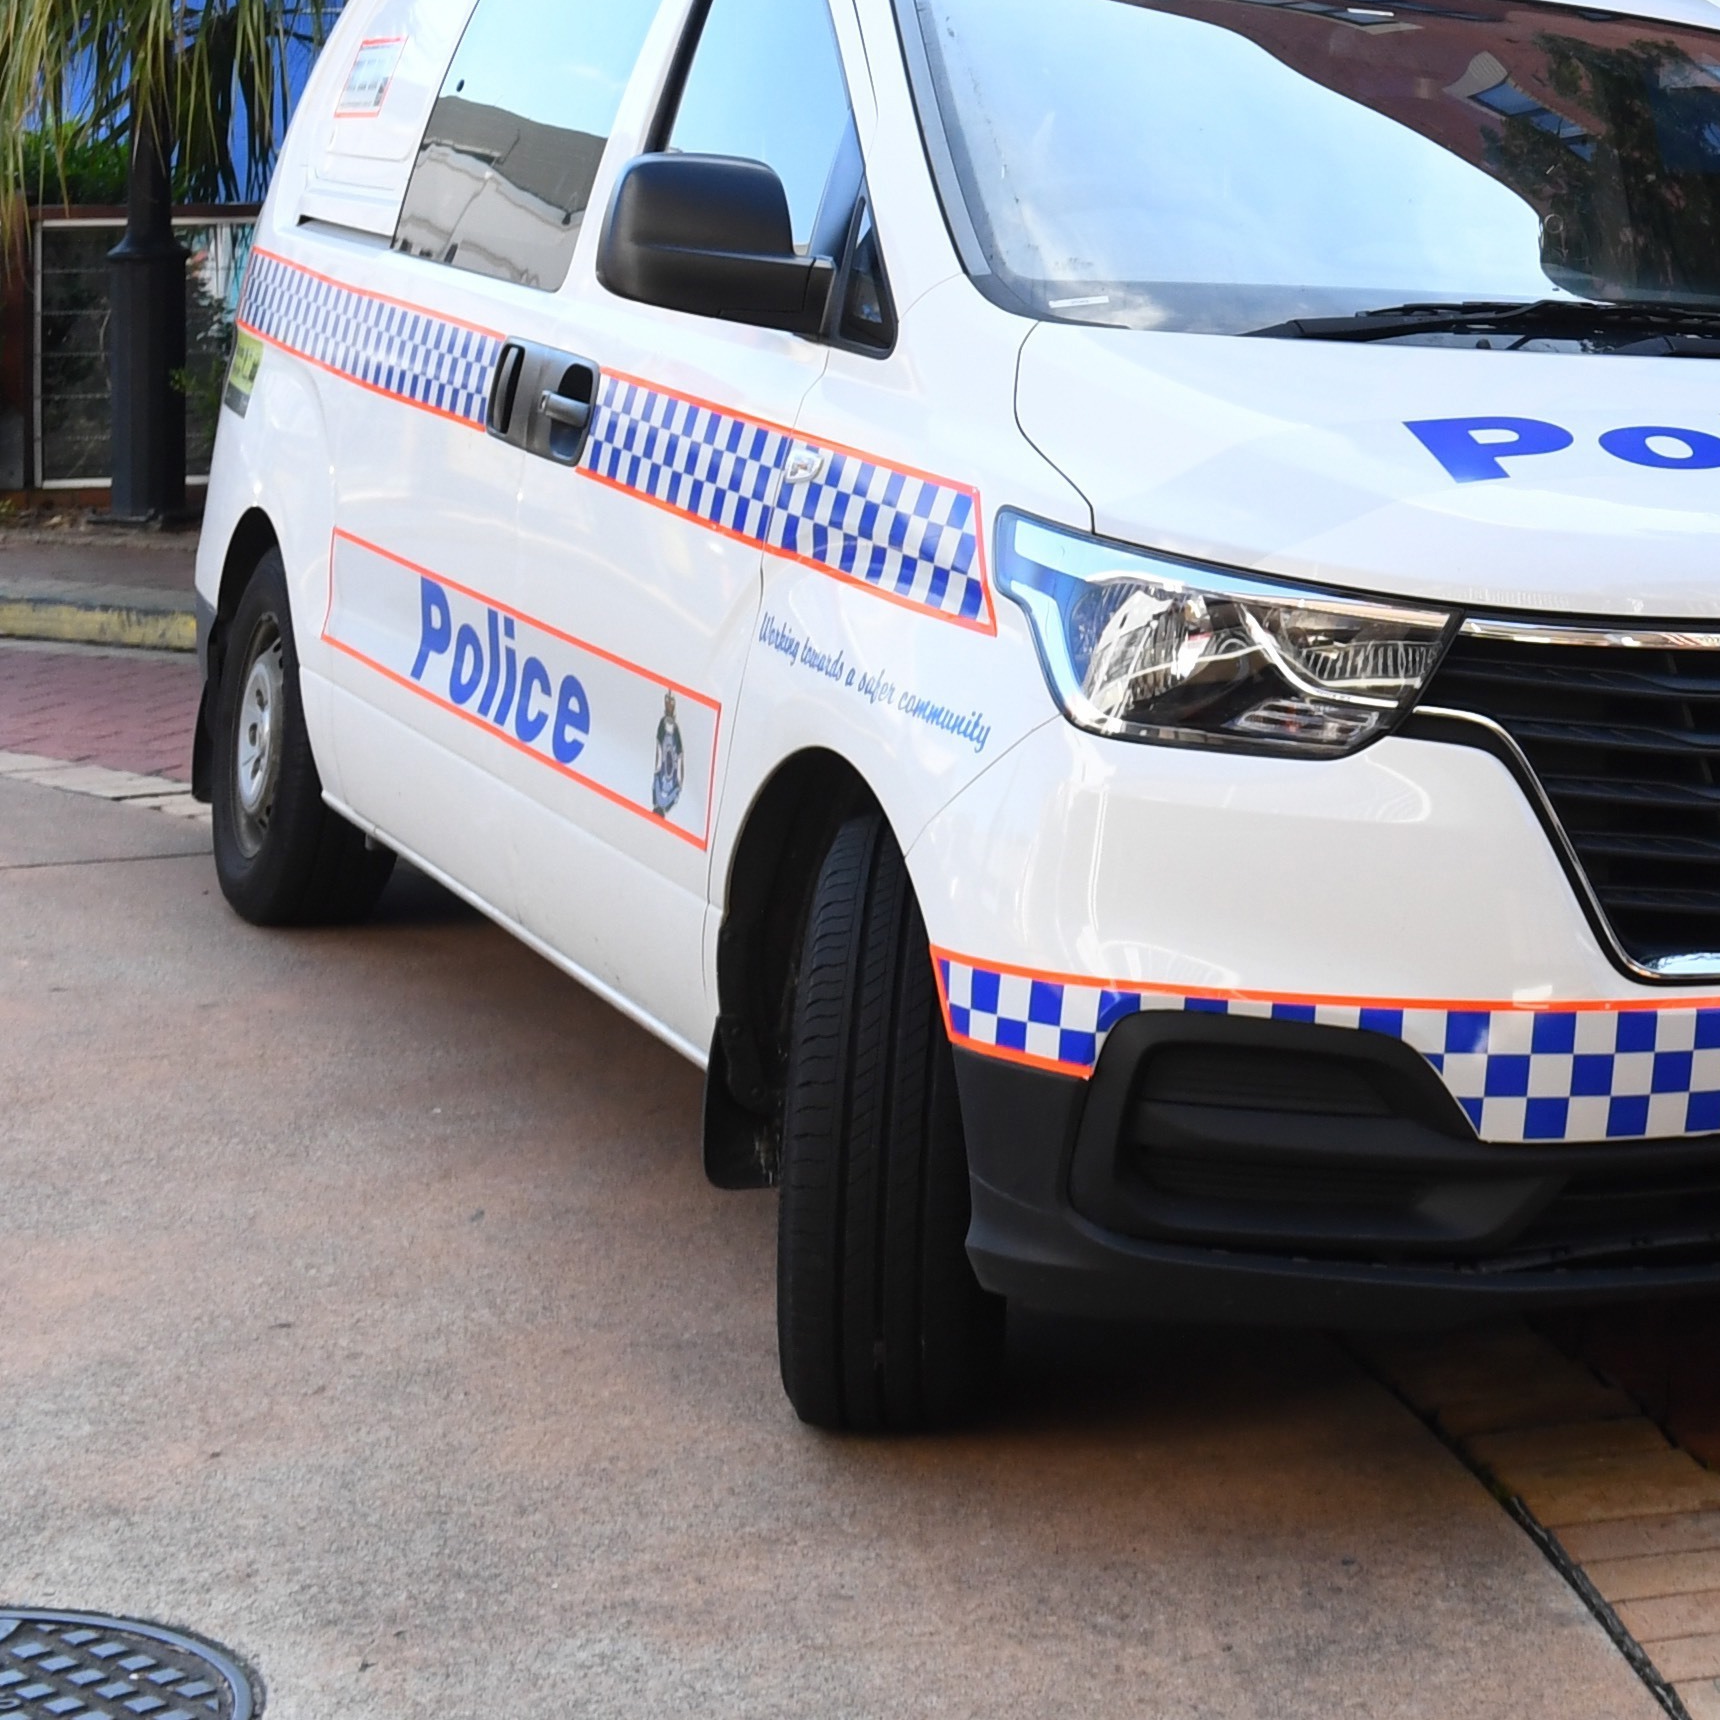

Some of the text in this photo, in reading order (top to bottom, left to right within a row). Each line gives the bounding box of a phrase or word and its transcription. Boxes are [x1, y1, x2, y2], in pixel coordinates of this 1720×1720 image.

[410, 575, 591, 764] Police
[759, 612, 992, 754] Working towards a safer community
